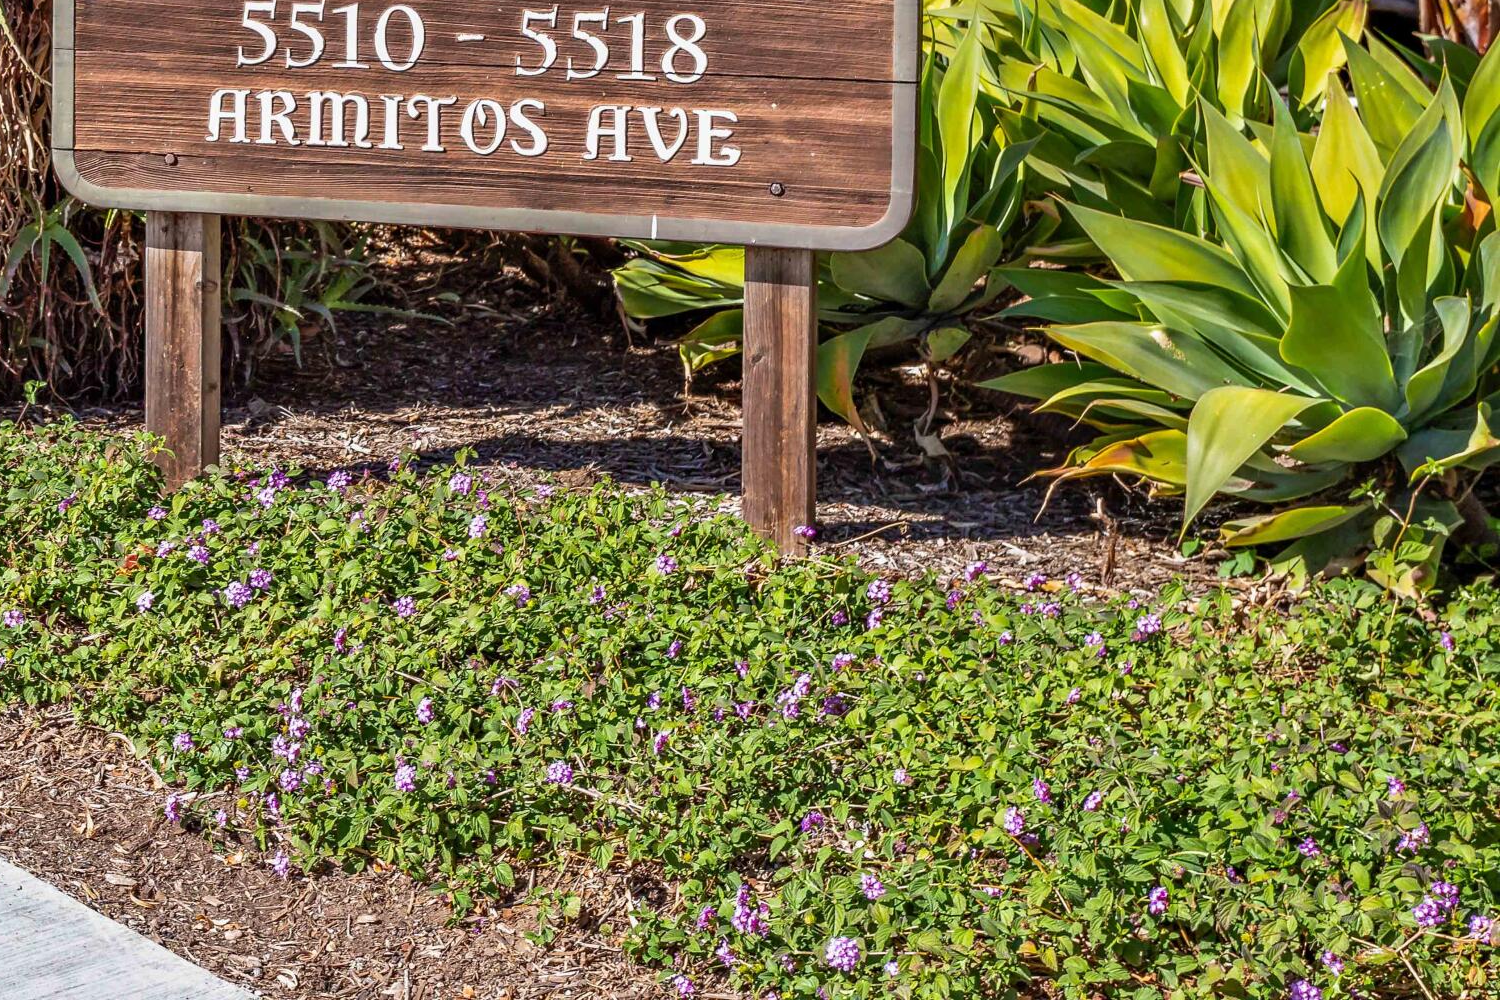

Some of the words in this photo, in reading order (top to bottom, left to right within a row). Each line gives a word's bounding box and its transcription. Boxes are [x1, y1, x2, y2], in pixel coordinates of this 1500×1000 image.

[456, 32, 484, 42] -
[515, 6, 708, 83] 5518
[205, 89, 548, 157] ARMITOS
[581, 105, 741, 166] AVE
